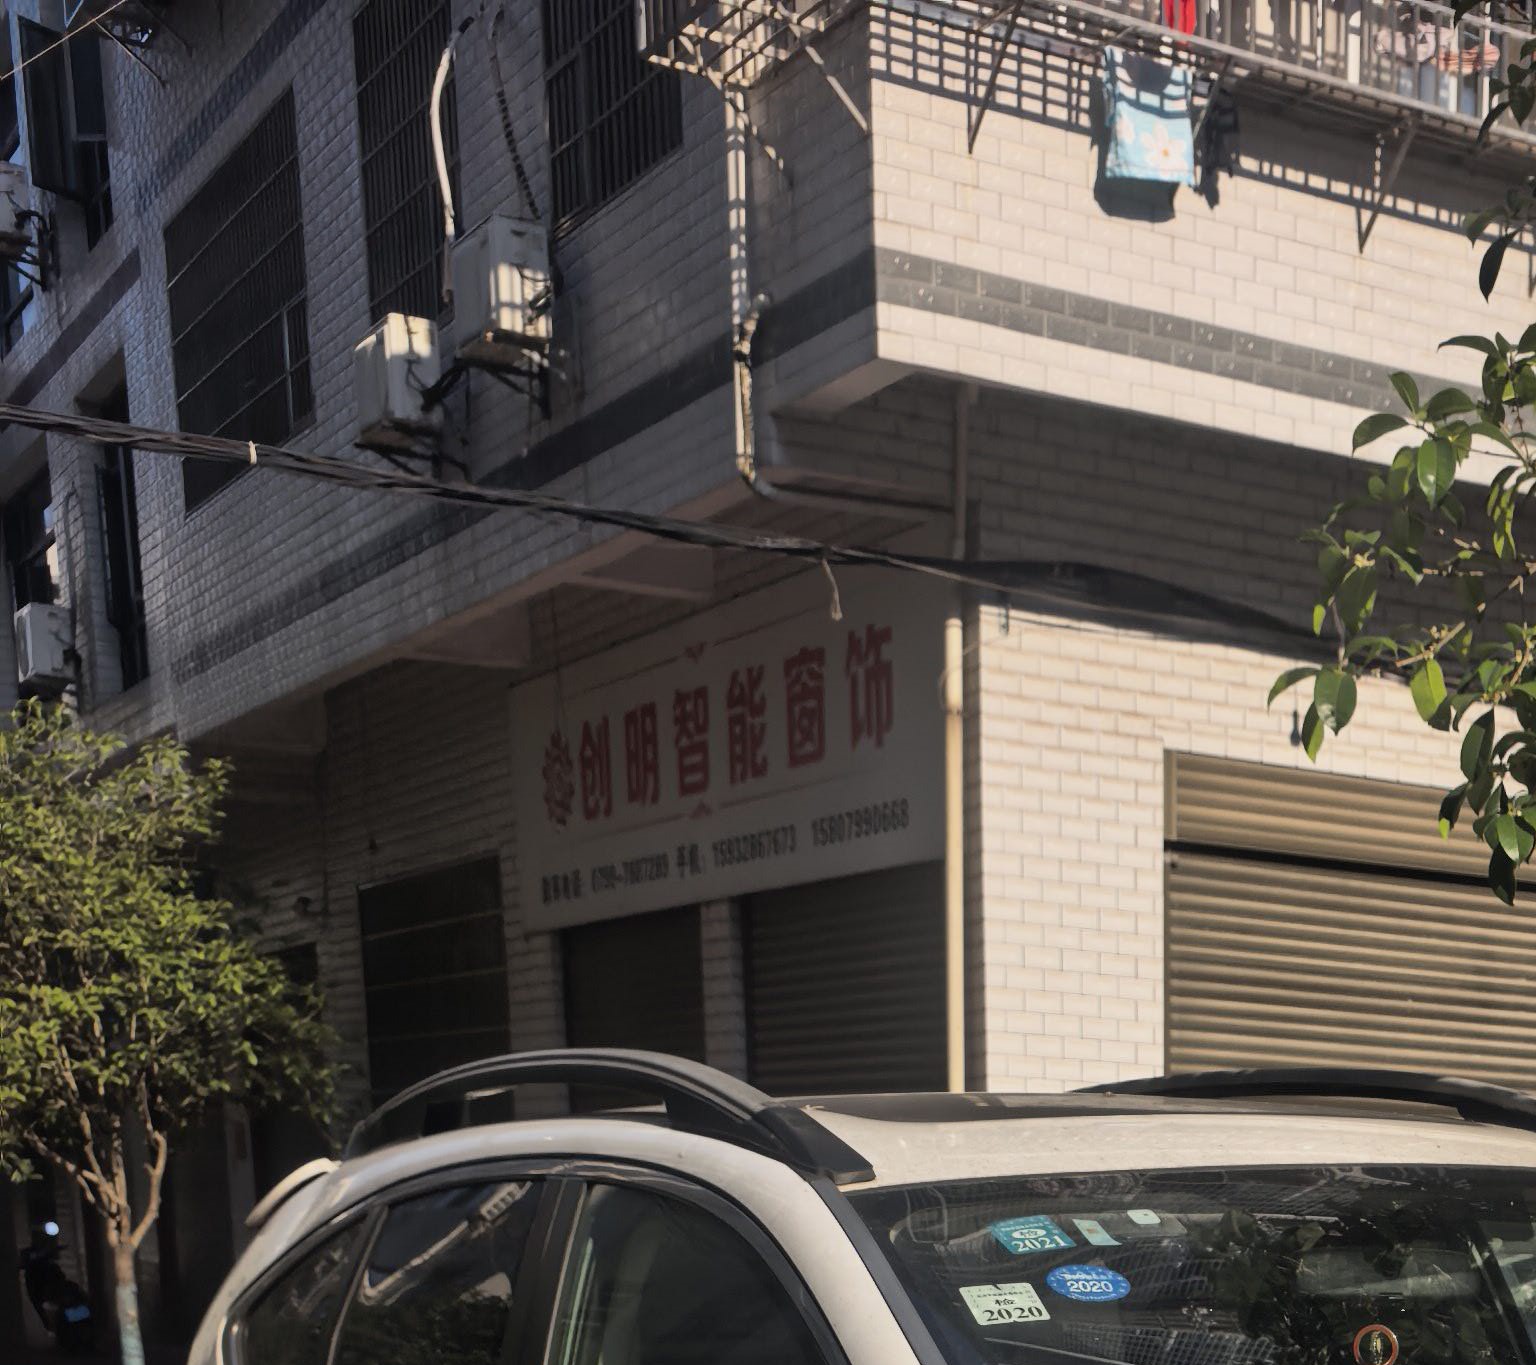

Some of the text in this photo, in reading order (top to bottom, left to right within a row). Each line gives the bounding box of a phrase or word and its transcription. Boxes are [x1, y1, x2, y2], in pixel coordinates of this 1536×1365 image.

[578, 622, 895, 822] 创明智能窗饰
[1011, 1235, 1067, 1252] 2021
[1066, 1280, 1113, 1293] 2020
[982, 1306, 1043, 1322] 2020
